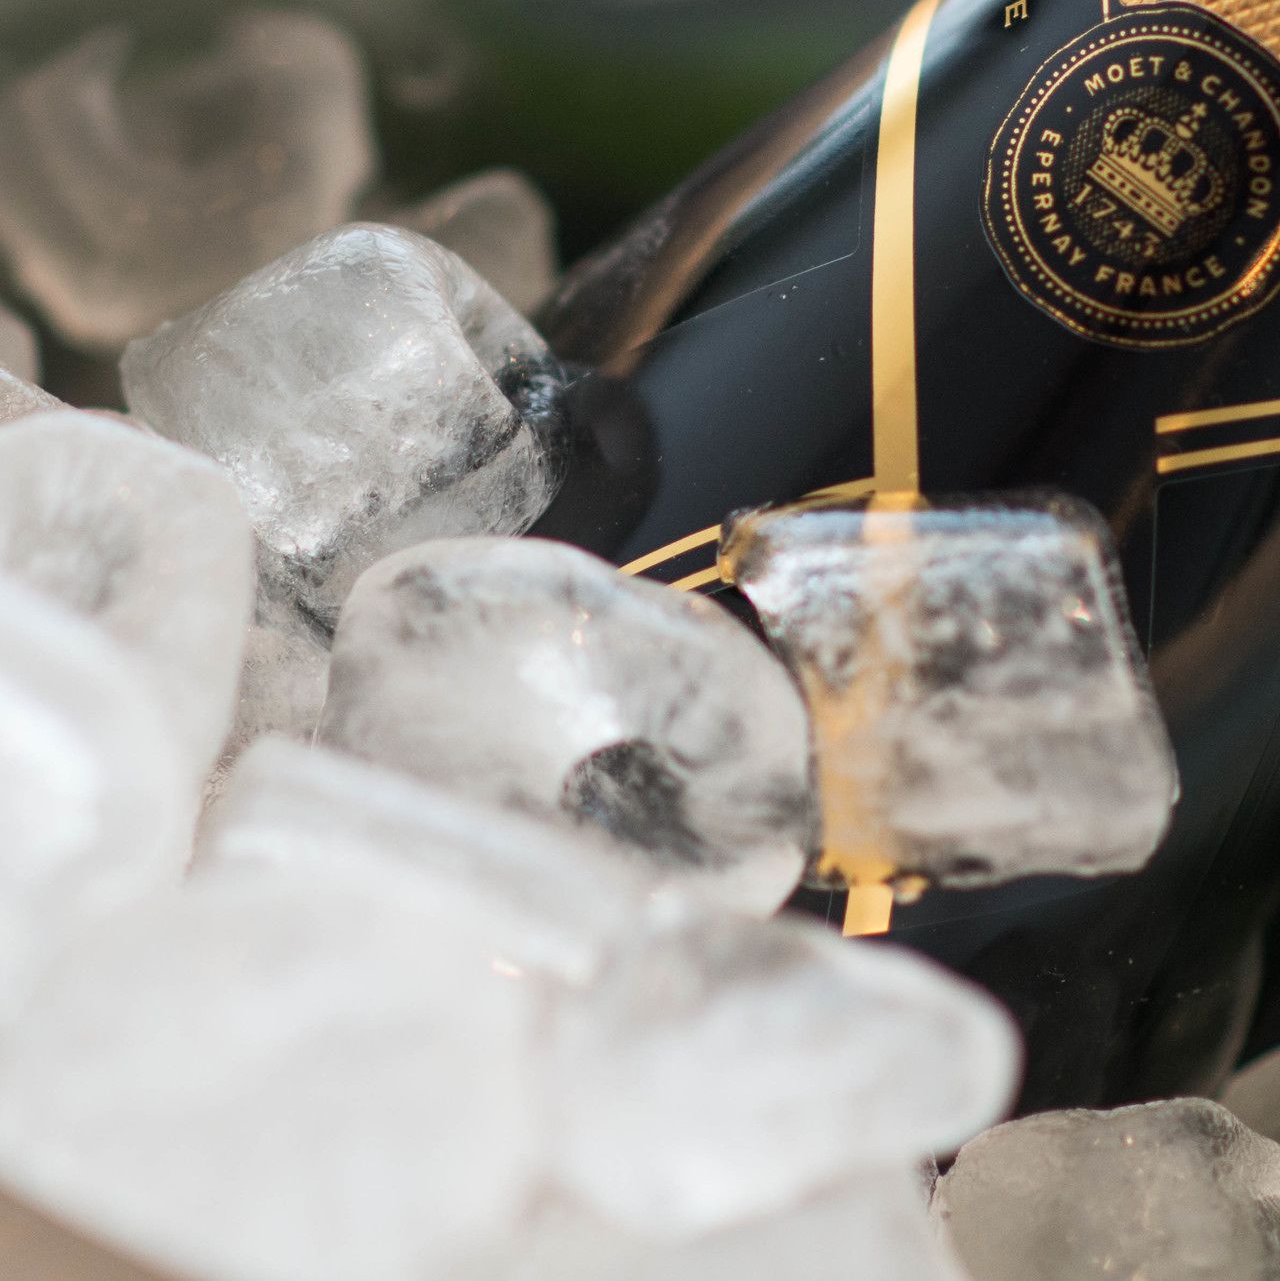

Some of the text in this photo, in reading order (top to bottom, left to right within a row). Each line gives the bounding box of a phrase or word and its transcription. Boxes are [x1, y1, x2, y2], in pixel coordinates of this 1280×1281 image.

[1174, 61, 1192, 81] &
[1201, 75, 1271, 218] CHANDON
[1073, 183, 1160, 259] 1743
[1094, 255, 1225, 295] FRANCE
